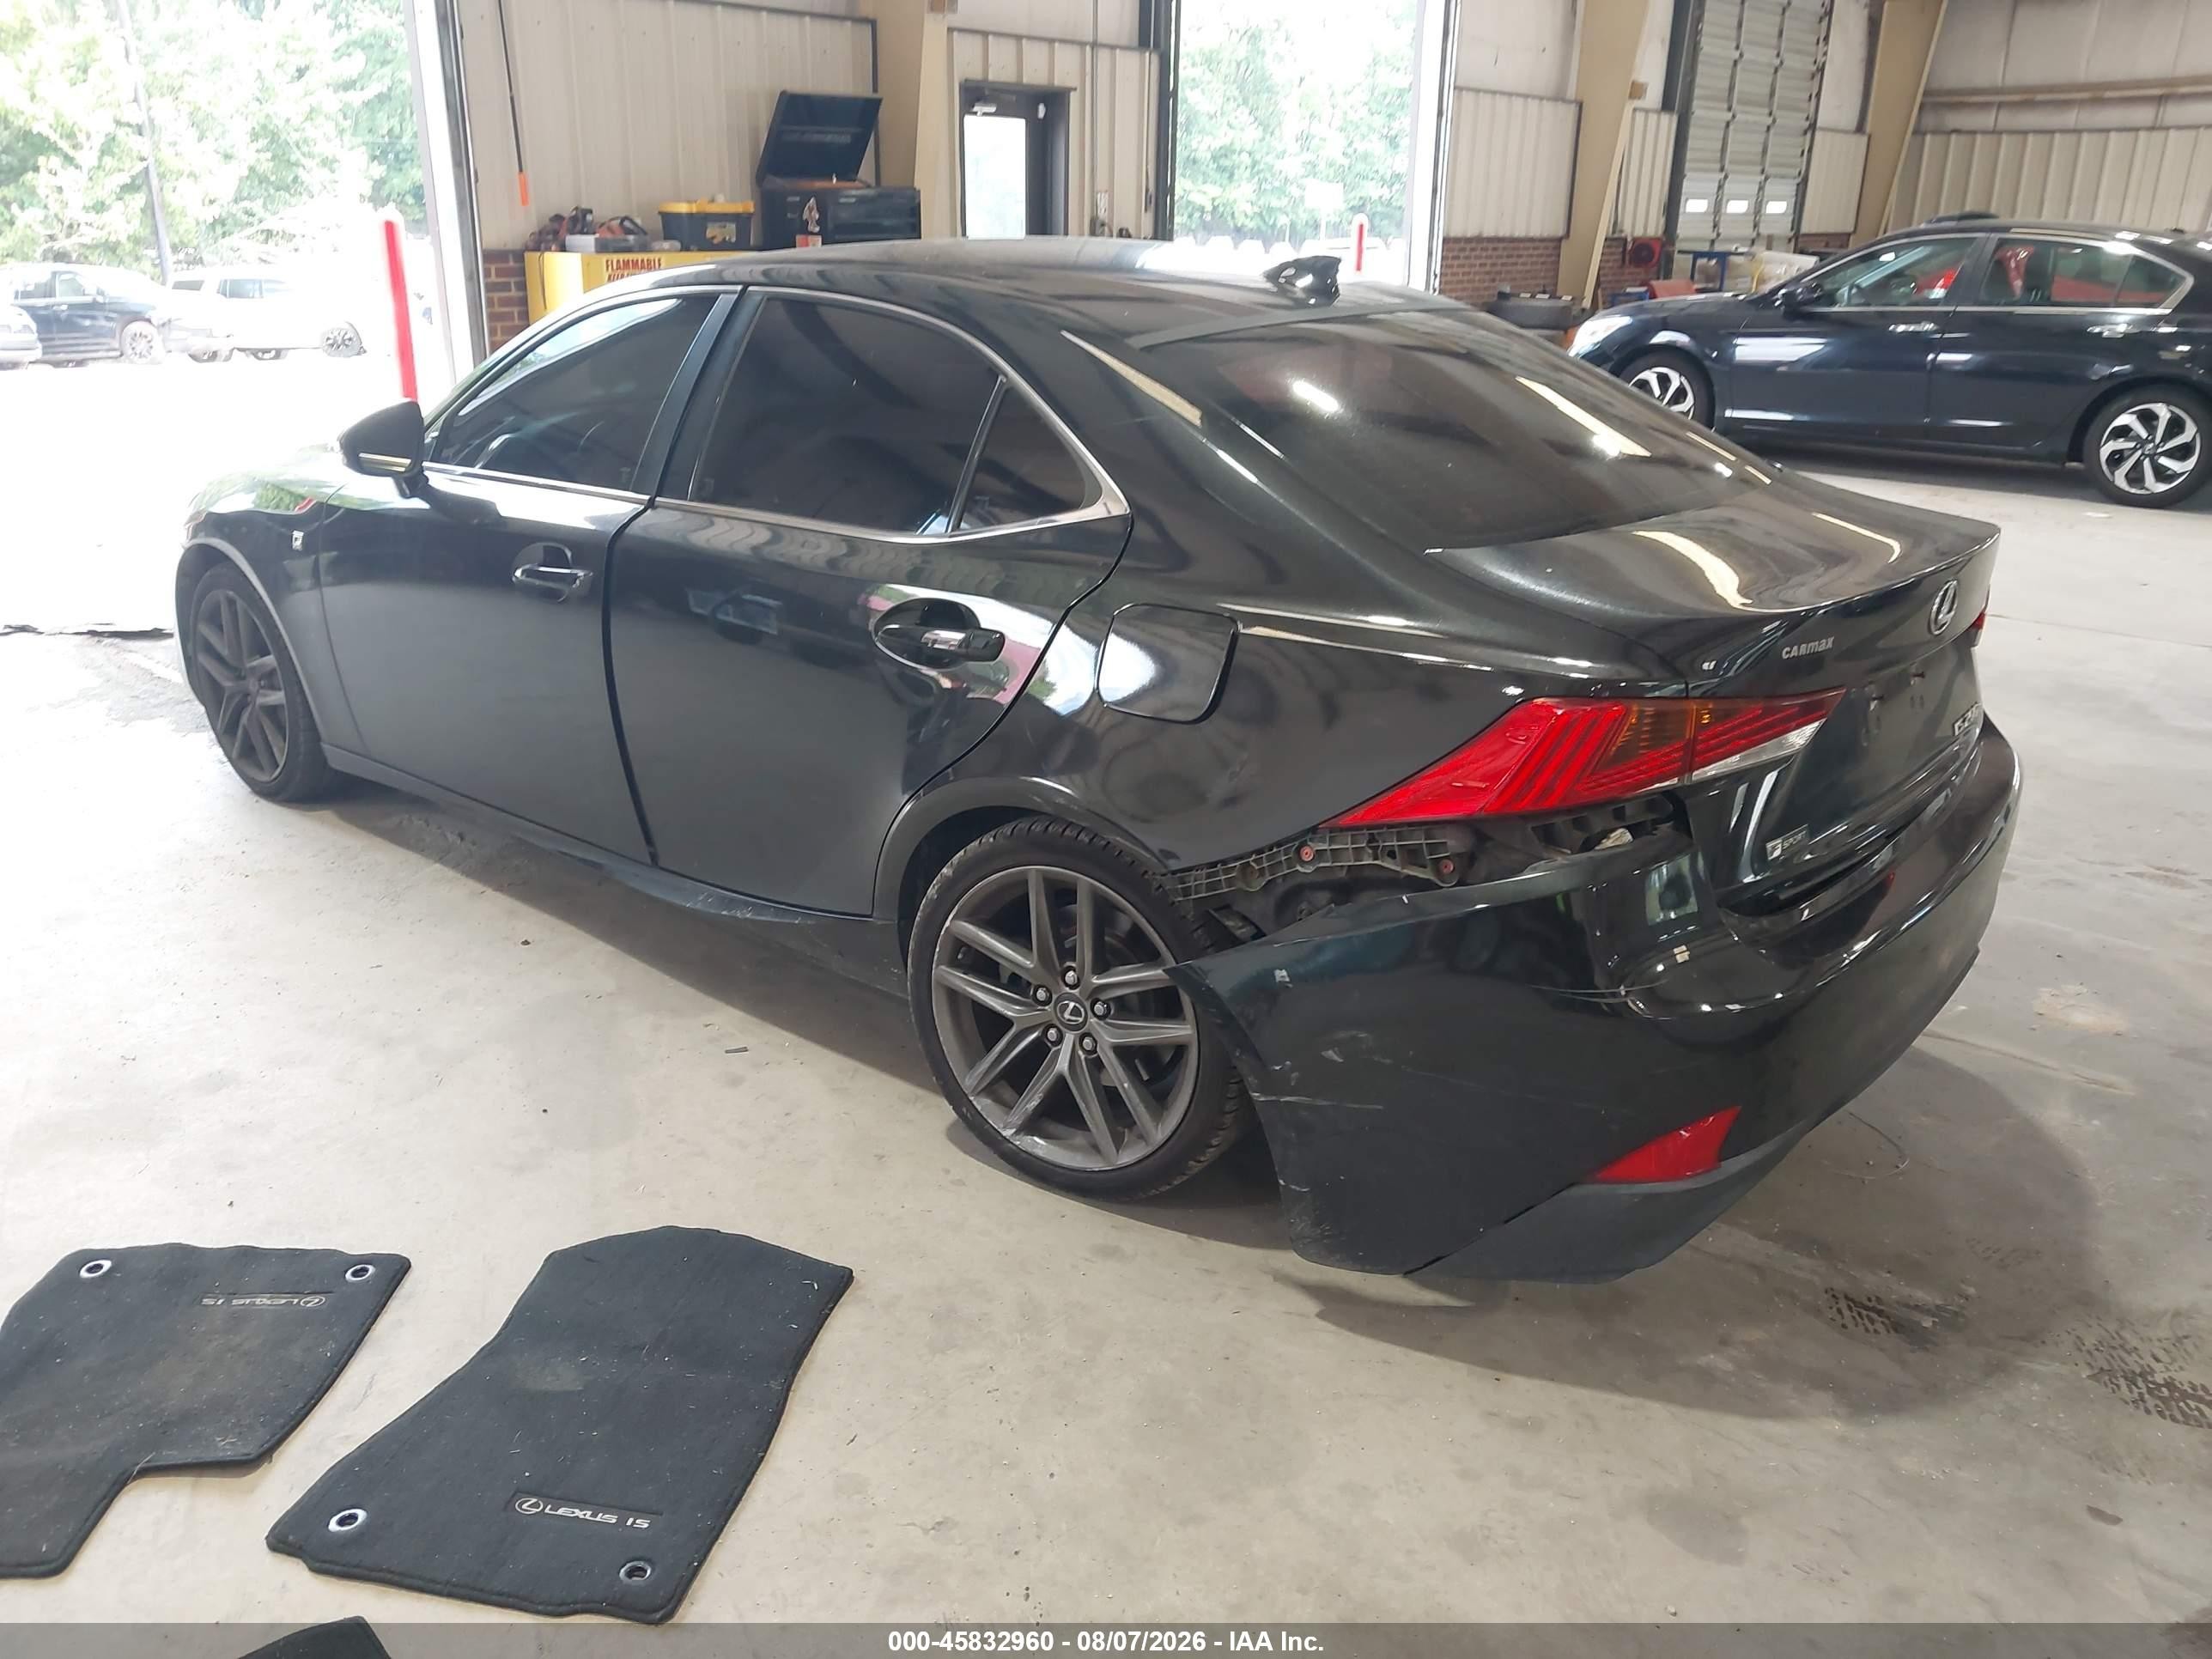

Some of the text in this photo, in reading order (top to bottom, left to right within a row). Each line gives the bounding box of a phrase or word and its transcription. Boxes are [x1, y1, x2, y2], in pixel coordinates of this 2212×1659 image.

[605, 258, 661, 271] FLAMMABLE
[201, 1297, 299, 1306] LEXUS IS
[544, 1504, 651, 1528] LEXUS IS
